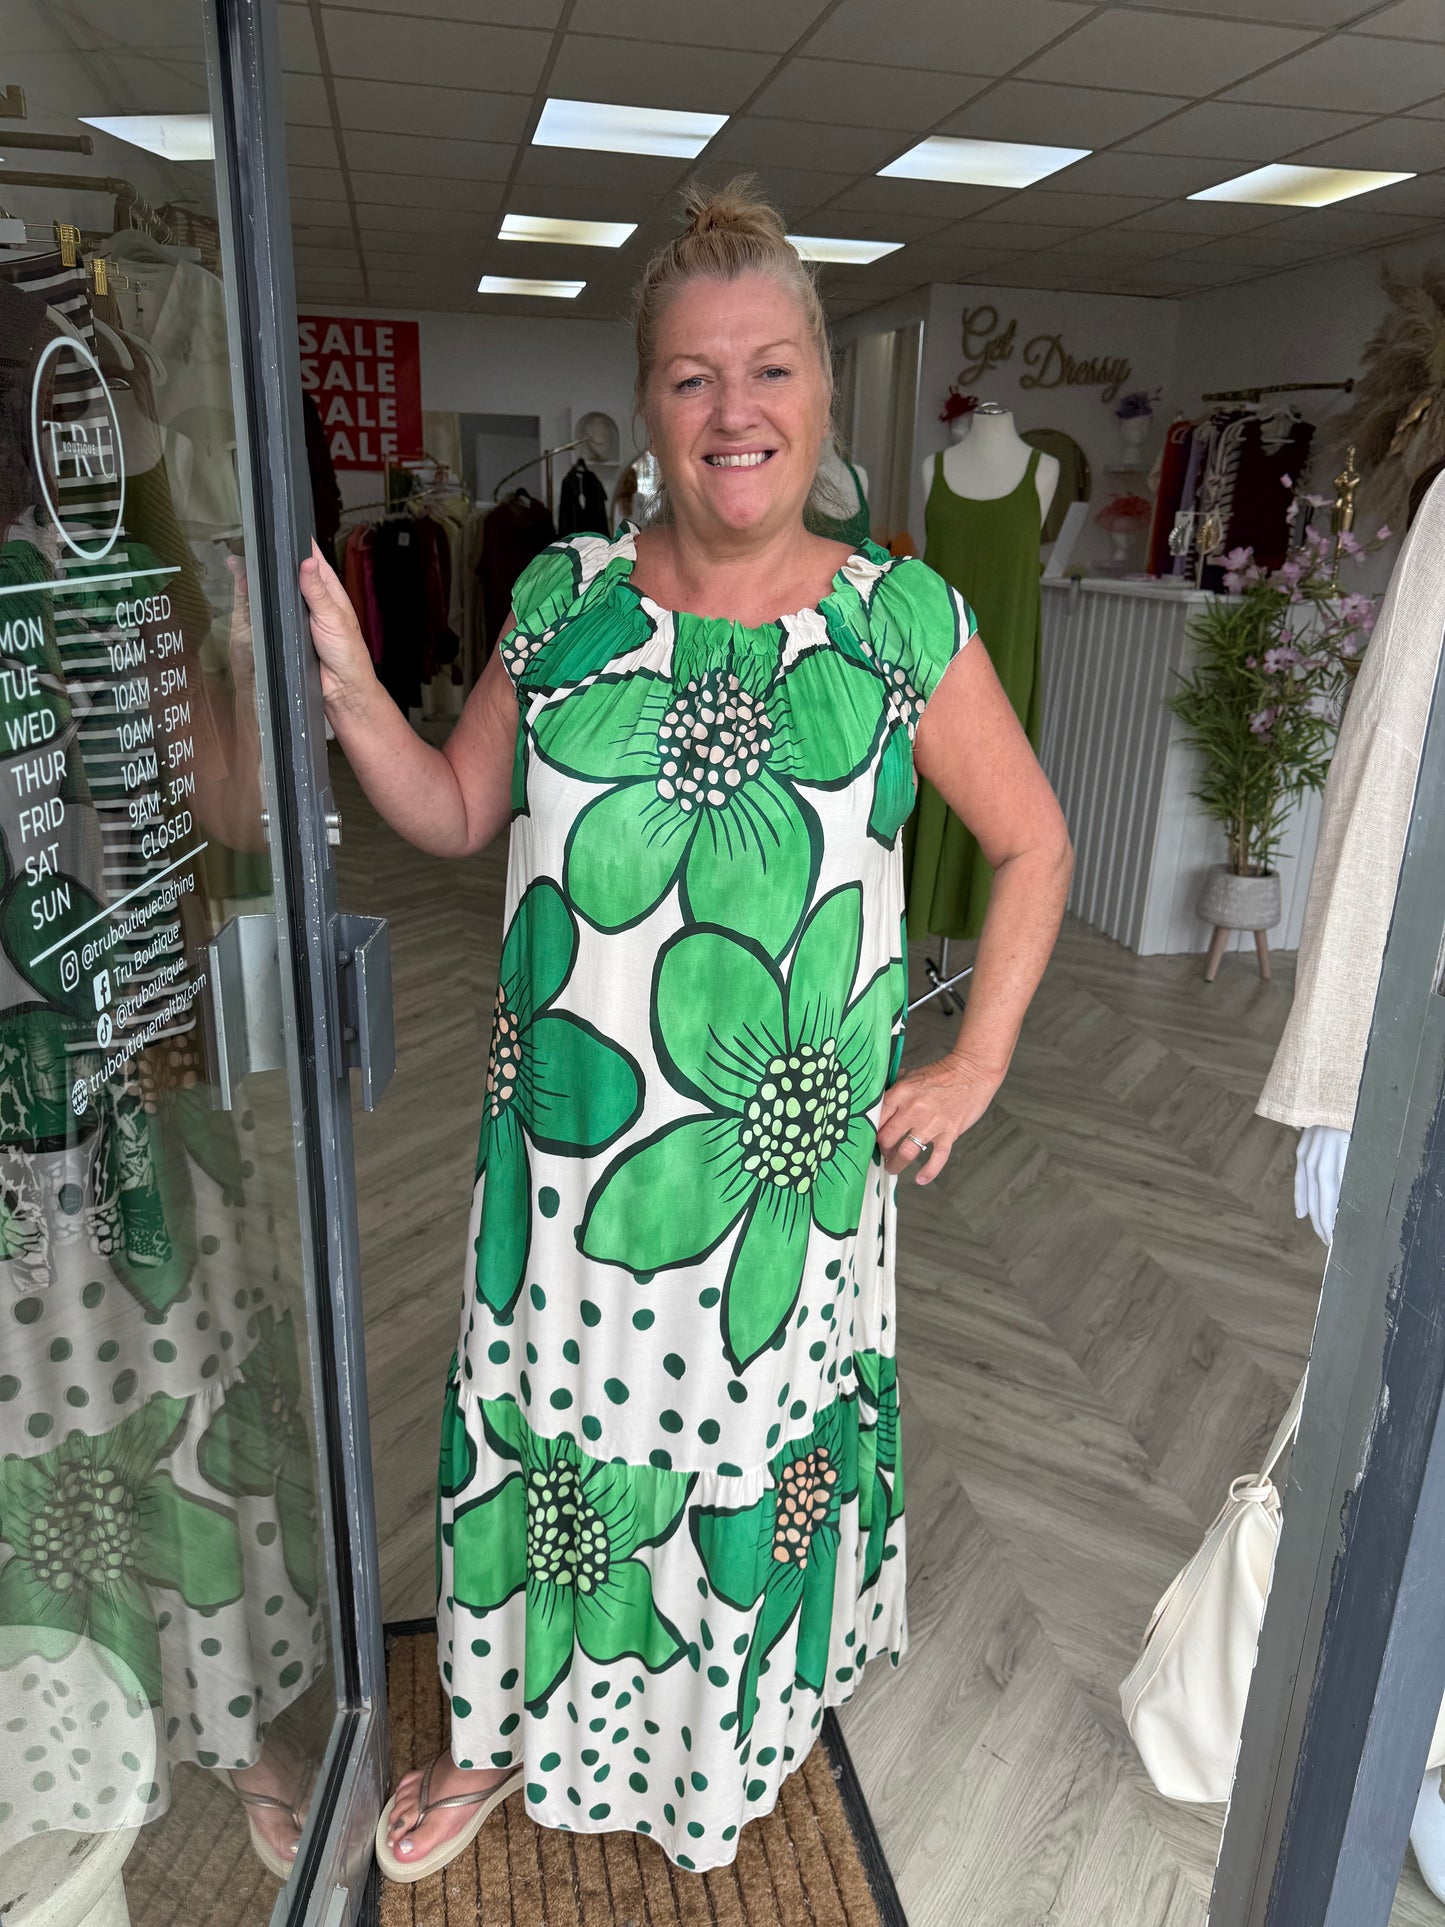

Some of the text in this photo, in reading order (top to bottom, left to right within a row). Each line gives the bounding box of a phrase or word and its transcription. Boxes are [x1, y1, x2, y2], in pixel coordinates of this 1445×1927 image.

[298, 322, 394, 358] SALE
[1019, 334, 1132, 404] Dressy
[301, 359, 396, 393] SALE
[309, 394, 398, 428] ALE
[42, 420, 116, 479] TRU
[62, 441, 97, 455] BOUTIQUE
[326, 430, 399, 462] ALE
[0, 594, 171, 653] MON CLOSED
[0, 664, 41, 704] TUE
[107, 638, 146, 673] 10AM
[156, 629, 184, 659] 5PM
[5, 708, 56, 750] WED
[112, 679, 150, 713] 10AM
[160, 665, 188, 696] 5PM
[10, 750, 68, 797] THUR
[116, 715, 155, 752] 10AM
[164, 701, 191, 733] 5PM
[19, 797, 65, 843] FRID
[121, 752, 158, 792] 10AM
[167, 736, 194, 769] 5PM
[25, 842, 60, 887] SAT
[128, 791, 160, 828] 9AM
[169, 771, 195, 806] 3PM
[30, 810, 193, 930] SUN CLOSED
[82, 872, 195, 971] @truboutiqueclothing
[113, 923, 180, 987] Tru Boutique
[116, 957, 185, 1029] @truboutique
[90, 973, 208, 1093] truboutiquemaltby.com
